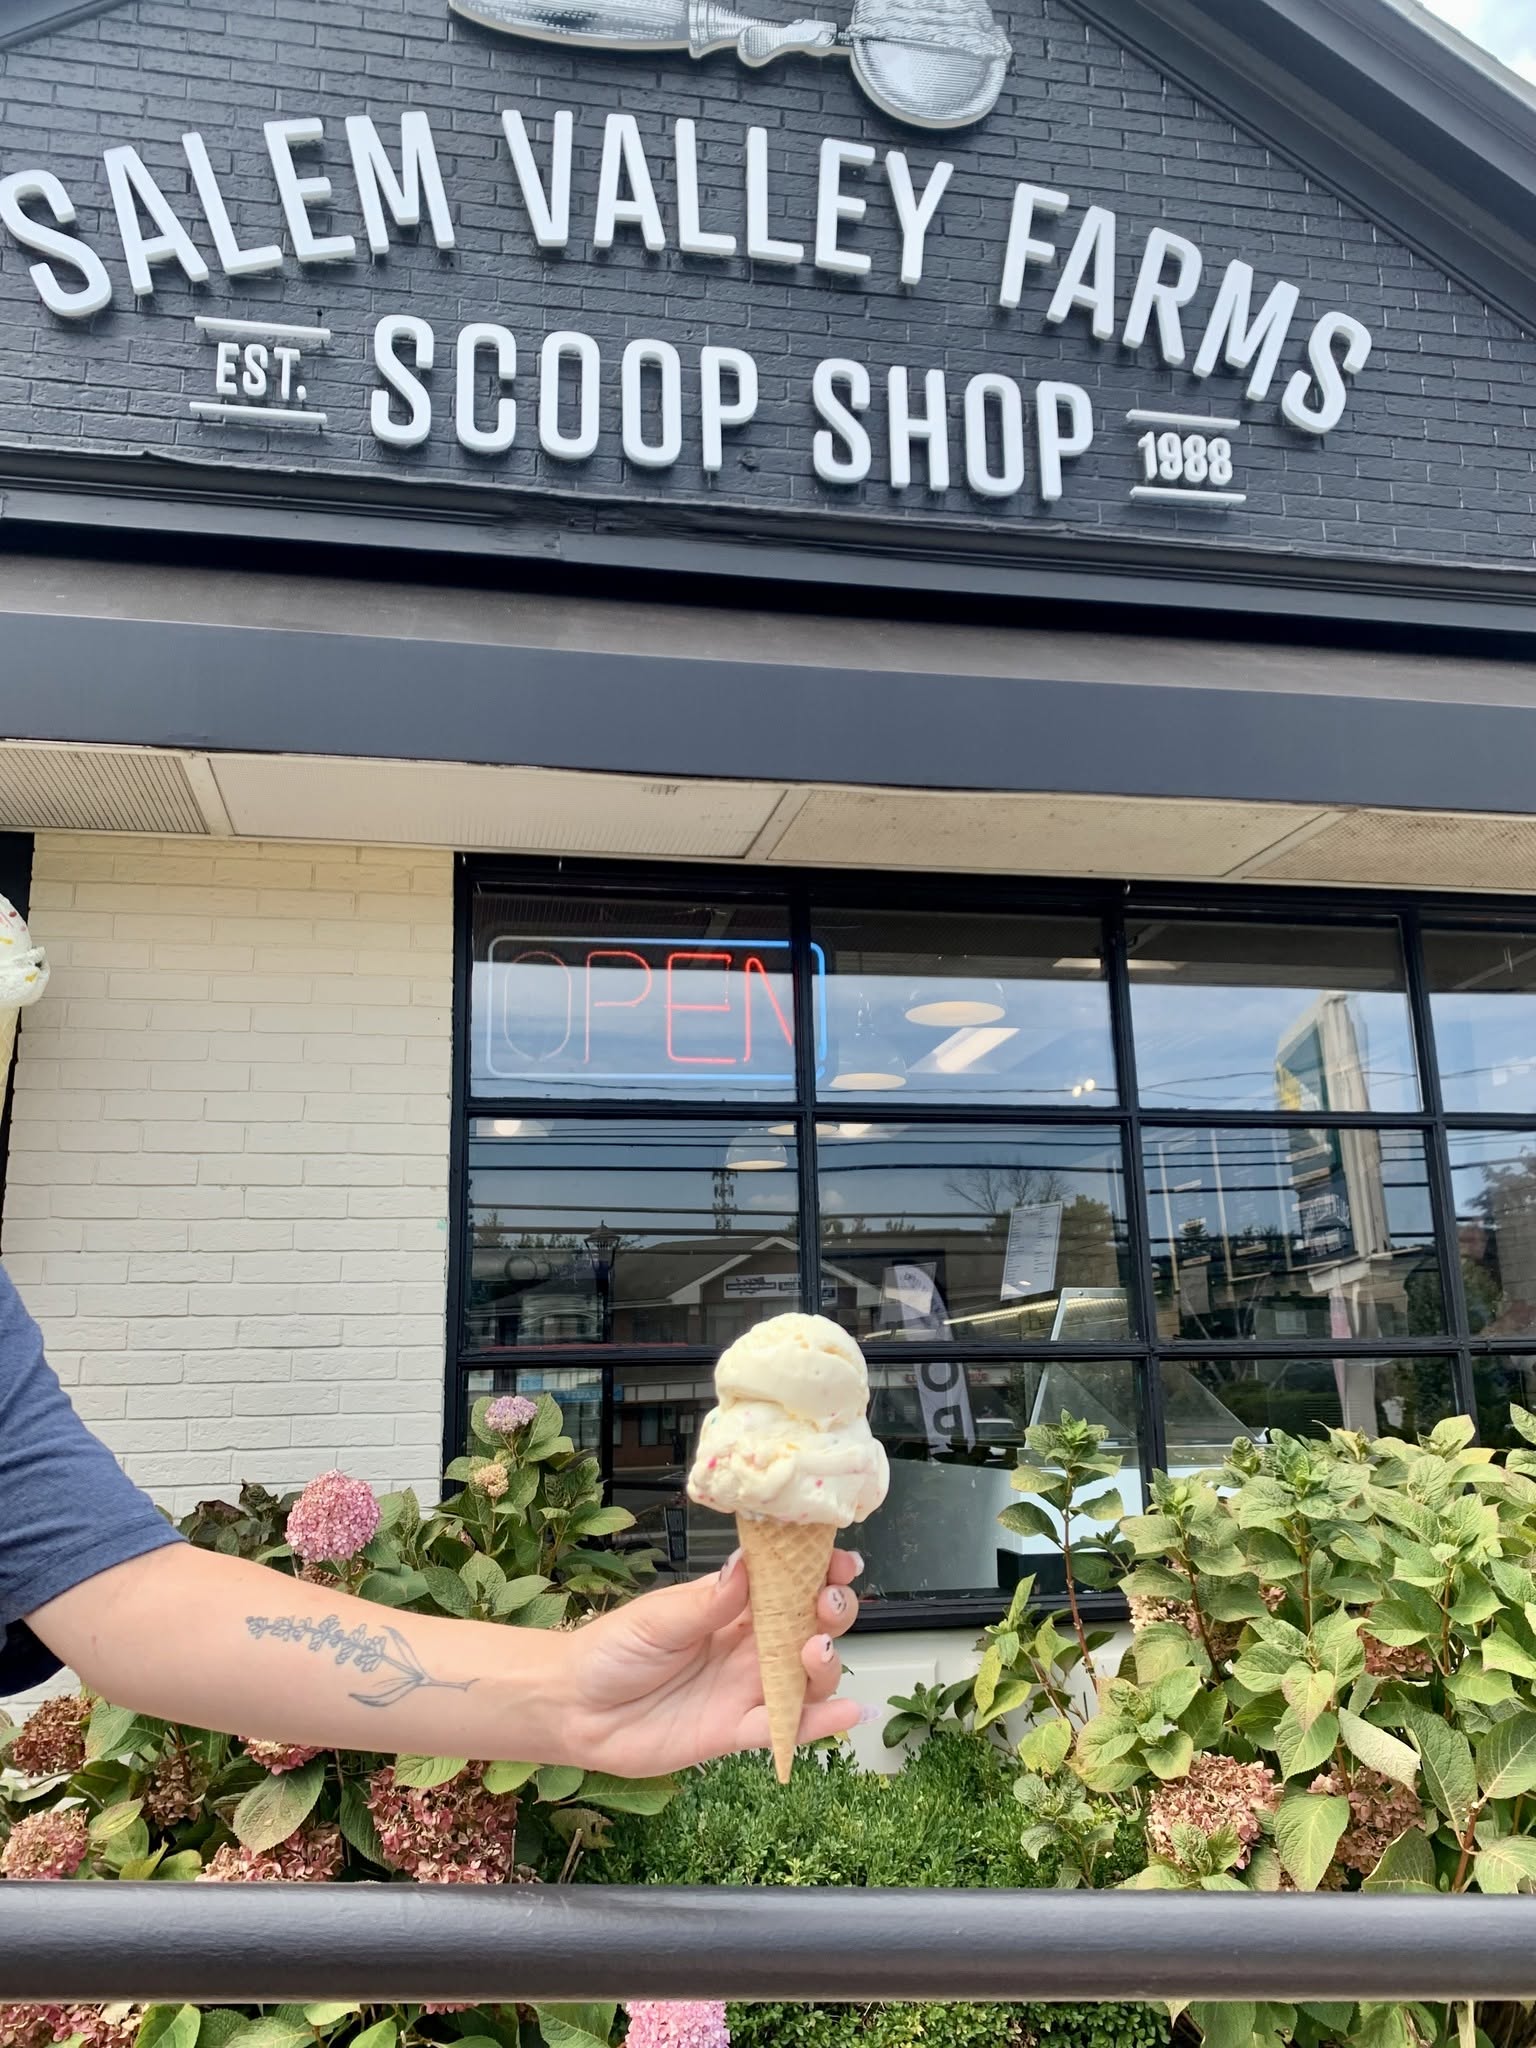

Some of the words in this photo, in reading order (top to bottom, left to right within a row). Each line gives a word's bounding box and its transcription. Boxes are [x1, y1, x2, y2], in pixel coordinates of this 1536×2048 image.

[0, 110, 455, 316] SALEM
[502, 109, 955, 285] VALLEY
[999, 182, 1372, 434] FARMS
[215, 341, 307, 401] EST.
[370, 314, 758, 470] SCOOP
[812, 358, 1094, 500] SHOP
[1137, 431, 1233, 486] 1988
[503, 950, 796, 1063] OPEN
